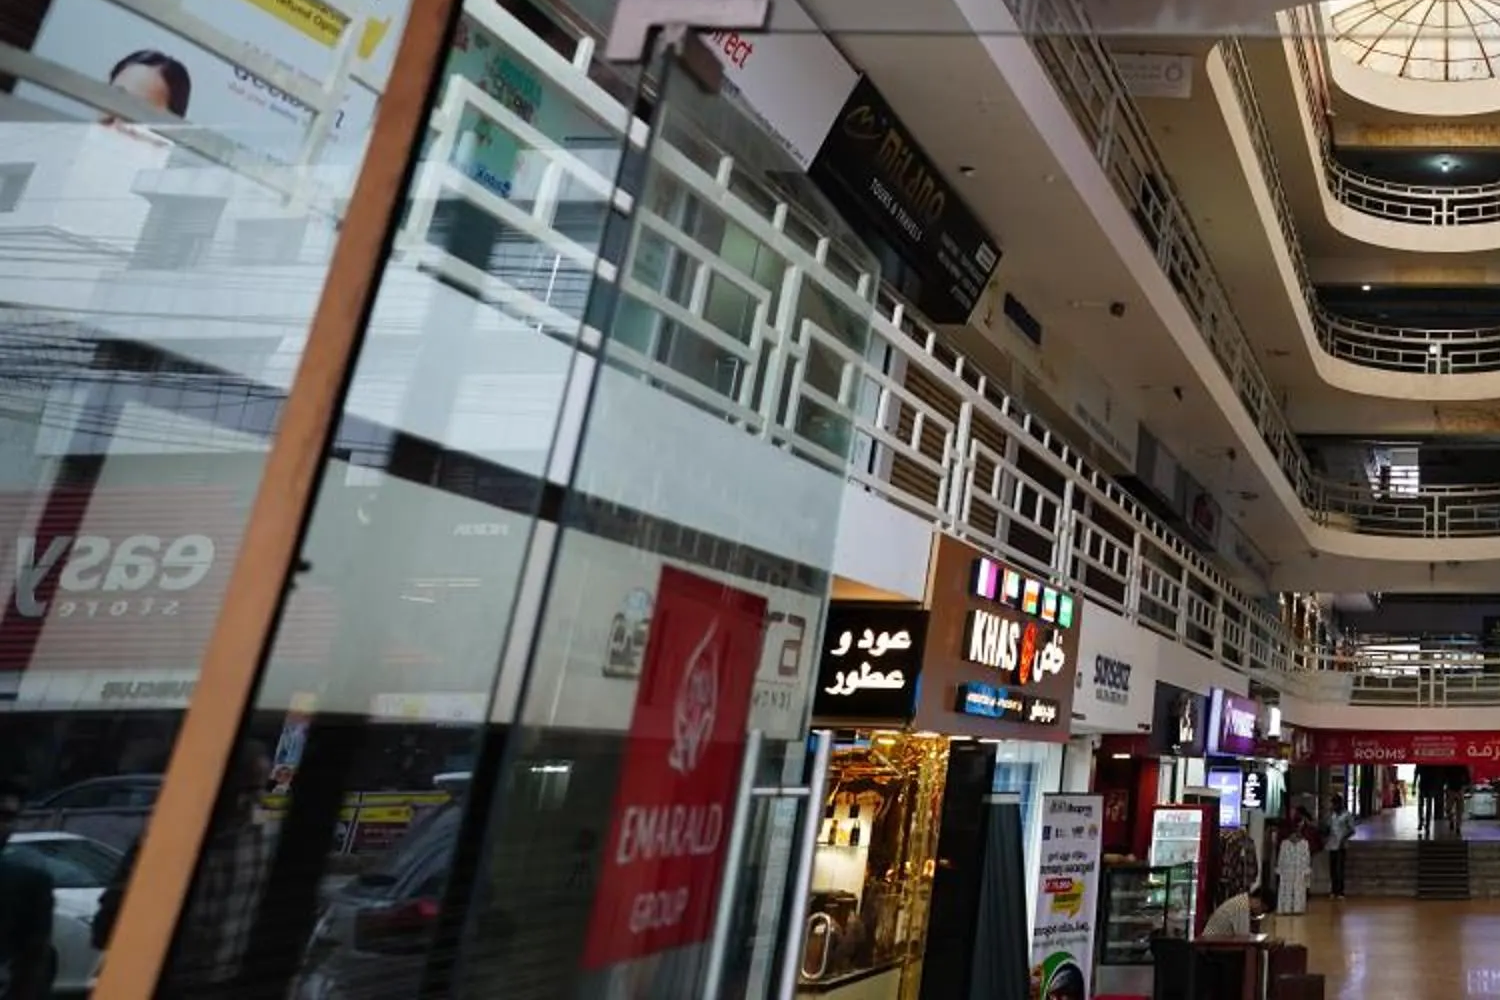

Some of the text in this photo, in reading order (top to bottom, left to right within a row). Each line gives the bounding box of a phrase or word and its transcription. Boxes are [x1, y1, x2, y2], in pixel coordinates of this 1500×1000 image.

[858, 628, 912, 656] عود
[969, 609, 1020, 671] KHAS
[825, 662, 905, 695] عطور
[1353, 747, 1407, 761] ROOMS
[616, 804, 722, 866] EMARALD
[630, 887, 689, 934] GROUP
